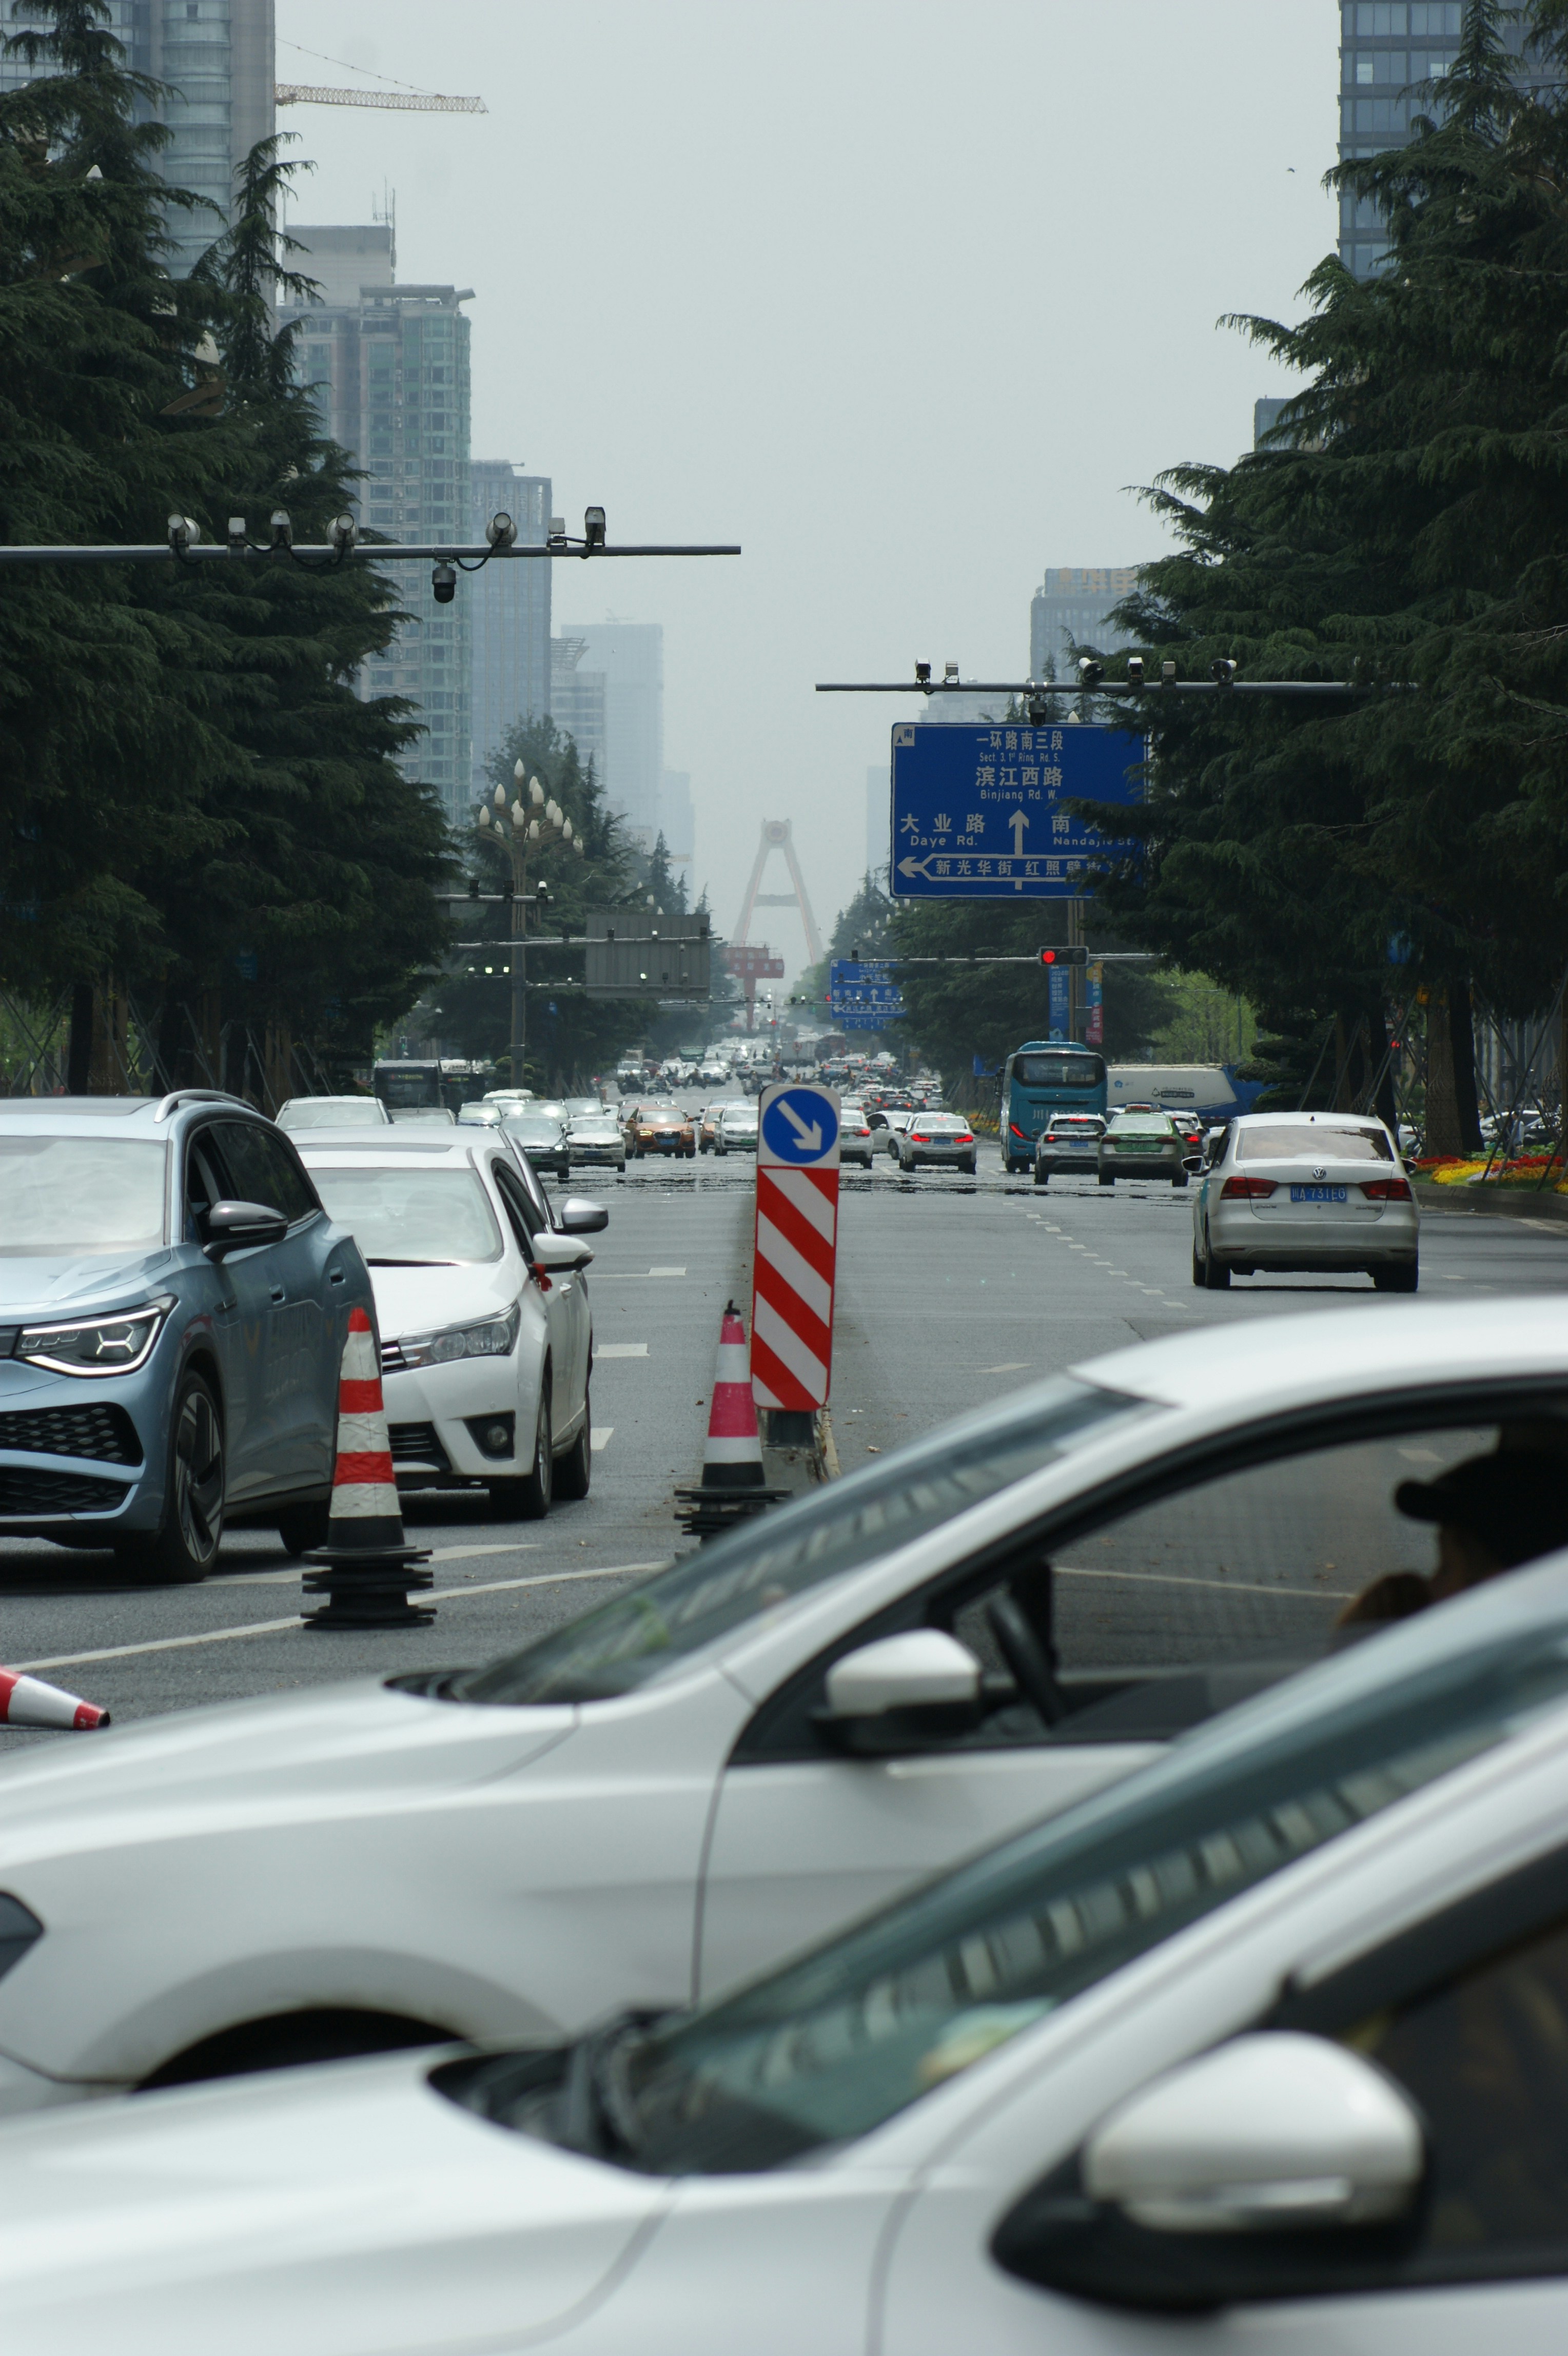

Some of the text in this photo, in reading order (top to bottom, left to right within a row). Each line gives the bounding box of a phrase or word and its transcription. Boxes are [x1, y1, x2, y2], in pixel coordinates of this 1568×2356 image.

[904, 729, 913, 739] 南
[976, 730, 1063, 750] 一环路南三段
[979, 752, 996, 762] Sect.
[1018, 753, 1034, 764] Ring
[1040, 753, 1050, 762] Rd.
[1053, 753, 1060, 762] S.
[975, 766, 1063, 787] 滨江西路
[981, 790, 1057, 802] Binjiang Rd. W.
[900, 813, 986, 833] 大业路
[911, 835, 977, 848] Daye Rd.
[936, 859, 1012, 876] 新光华街
